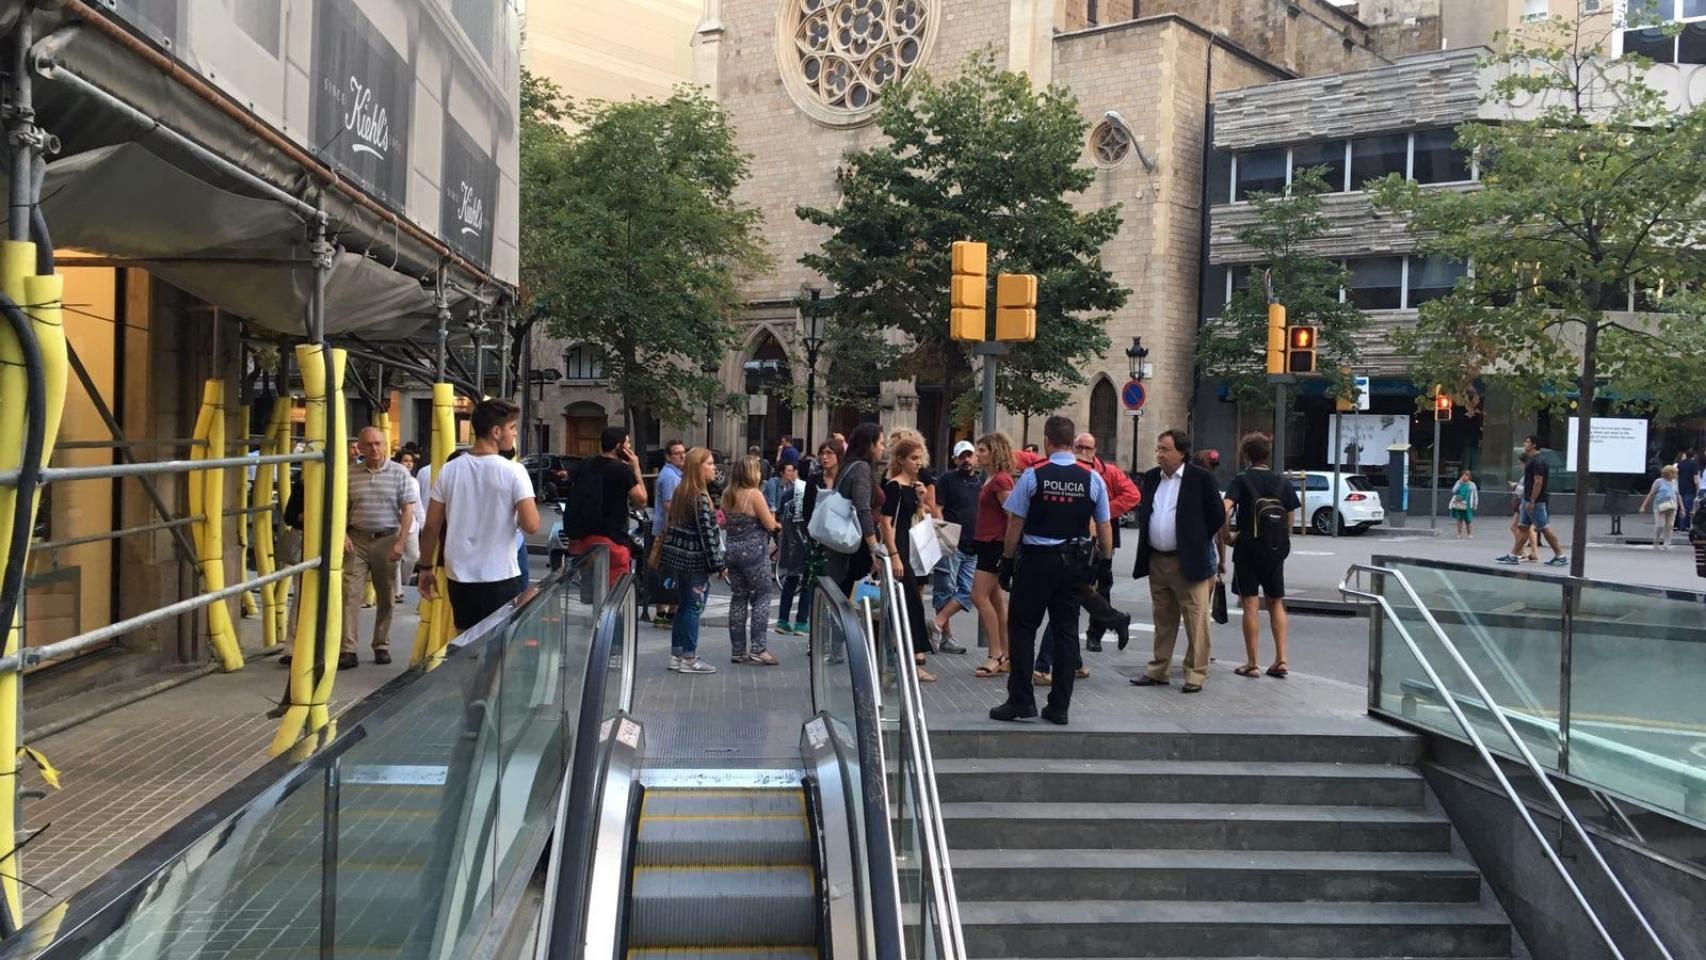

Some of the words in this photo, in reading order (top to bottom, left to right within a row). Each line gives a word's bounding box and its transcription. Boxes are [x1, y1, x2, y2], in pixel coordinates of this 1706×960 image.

[345, 75, 389, 152] Kiehl's
[457, 180, 483, 231] Kiehl's
[1043, 480, 1085, 493] POLICIA
